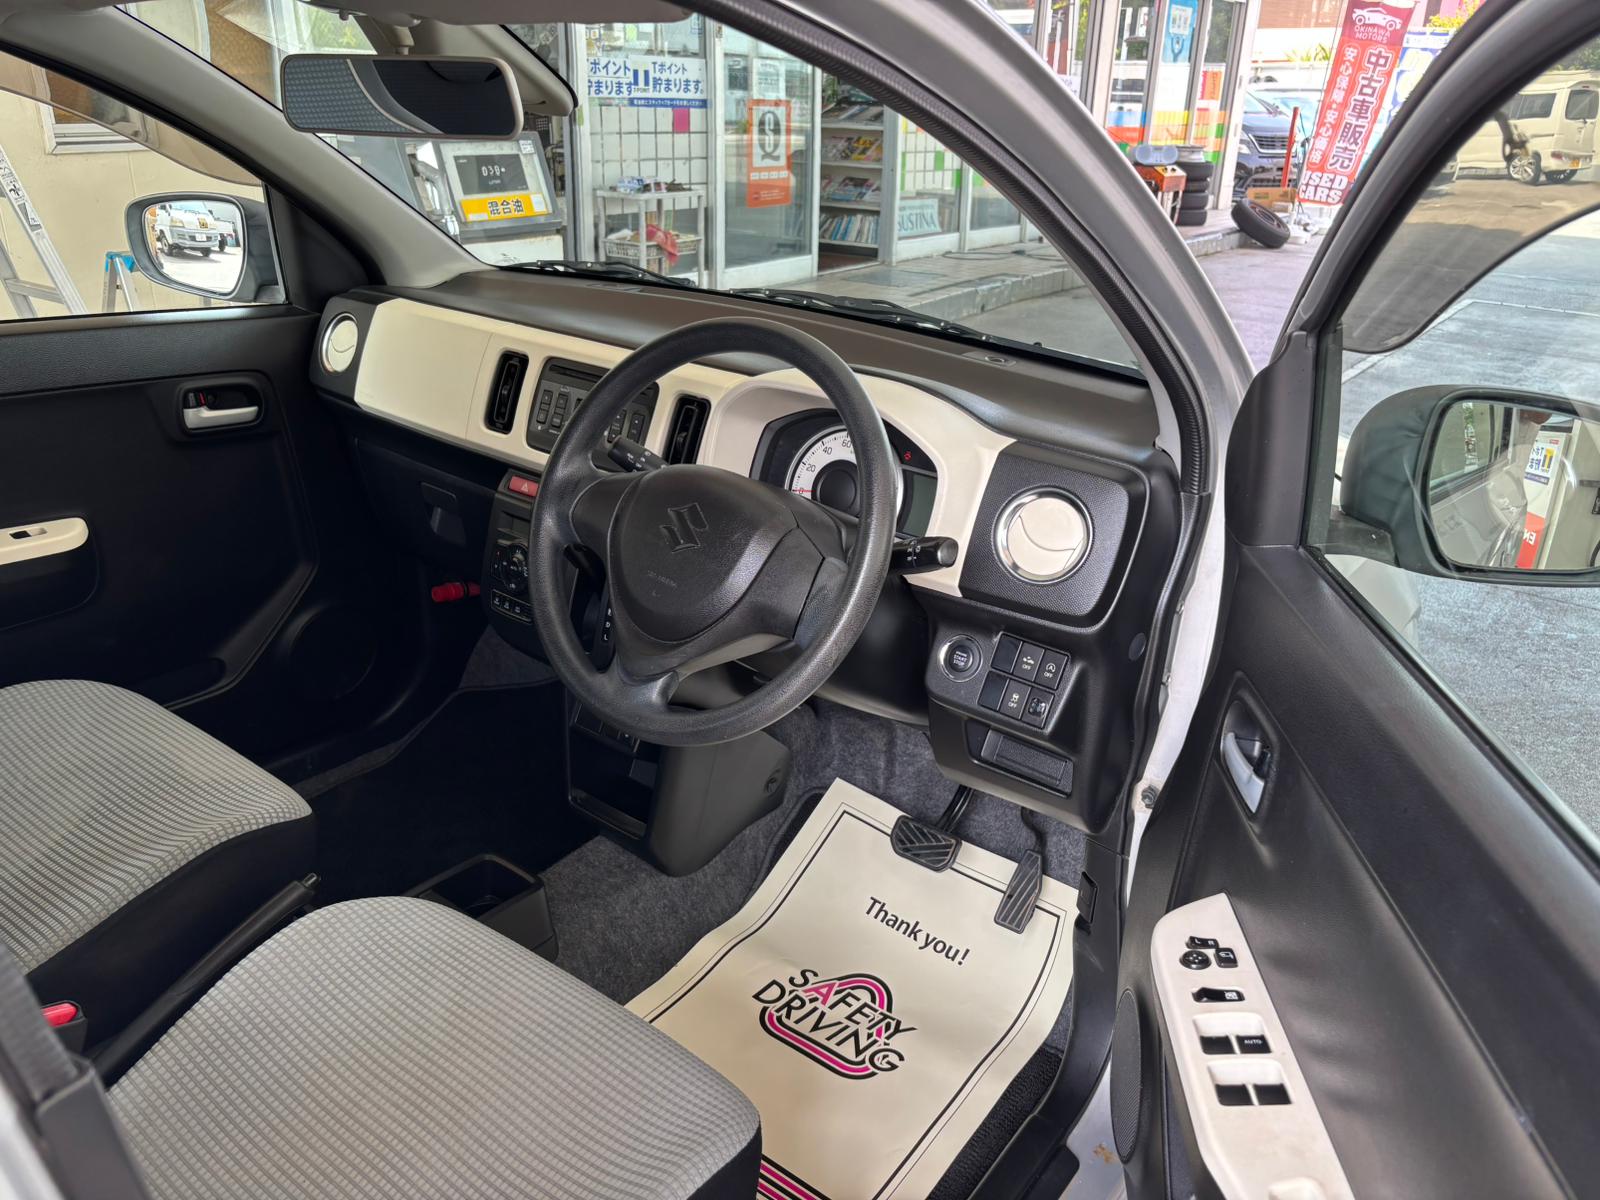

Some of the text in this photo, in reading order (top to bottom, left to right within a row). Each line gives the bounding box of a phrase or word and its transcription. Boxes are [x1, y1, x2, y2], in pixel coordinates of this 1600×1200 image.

[1354, 24, 1391, 38] OKINAWA
[1355, 31, 1388, 44] MOTORS
[587, 58, 631, 76] ポイント
[651, 61, 688, 75] Tポイント
[1328, 48, 1393, 170] 中古車販売
[1302, 170, 1349, 190] USED
[1298, 185, 1343, 204] CARS
[487, 198, 525, 216] 混合油
[822, 446, 833, 455] 40
[805, 463, 816, 473] 20
[1022, 663, 1031, 671] OFF
[1044, 671, 1053, 679] OFF
[864, 896, 971, 966] Thank you!
[788, 968, 918, 1041] SAFETY
[752, 979, 905, 1072] DRIVING
